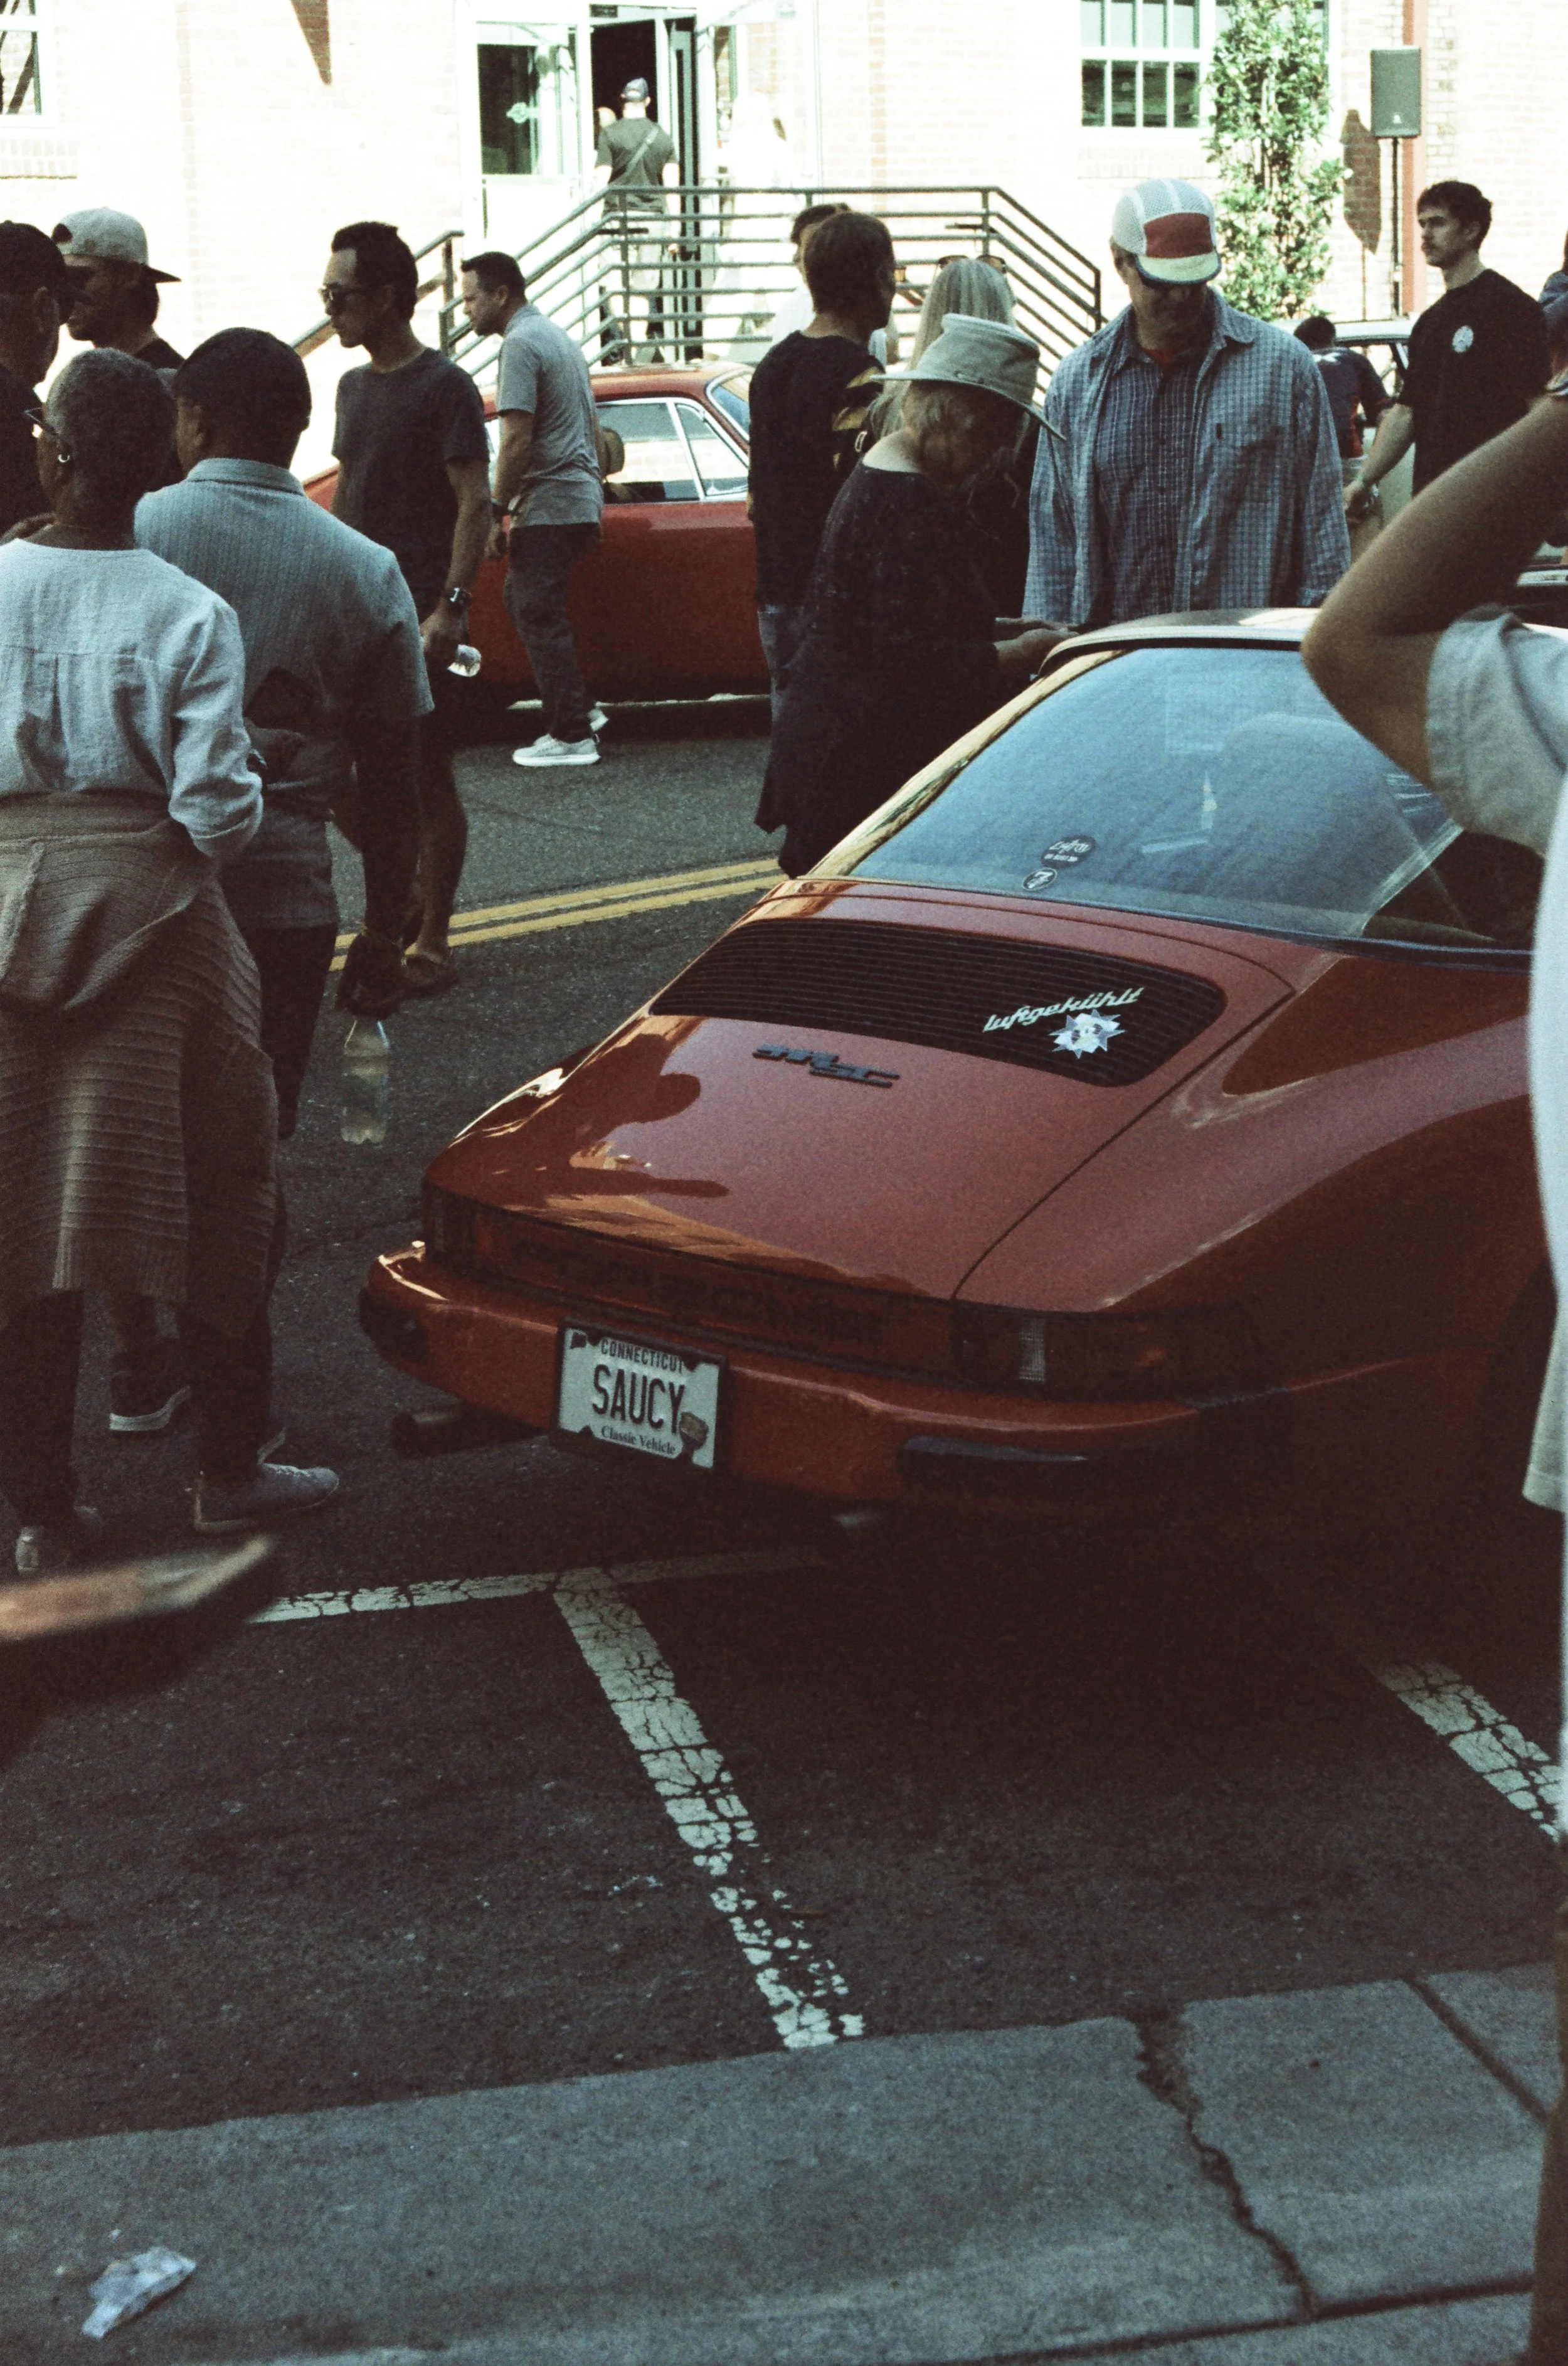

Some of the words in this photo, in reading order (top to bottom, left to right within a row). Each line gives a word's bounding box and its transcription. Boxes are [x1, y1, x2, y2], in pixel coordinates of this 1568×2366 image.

[601, 1337, 684, 1374] CONNECTICUT
[591, 1364, 686, 1435] SAUCY
[601, 1425, 637, 1445] Classic
[639, 1434, 676, 1455] Vehicle
